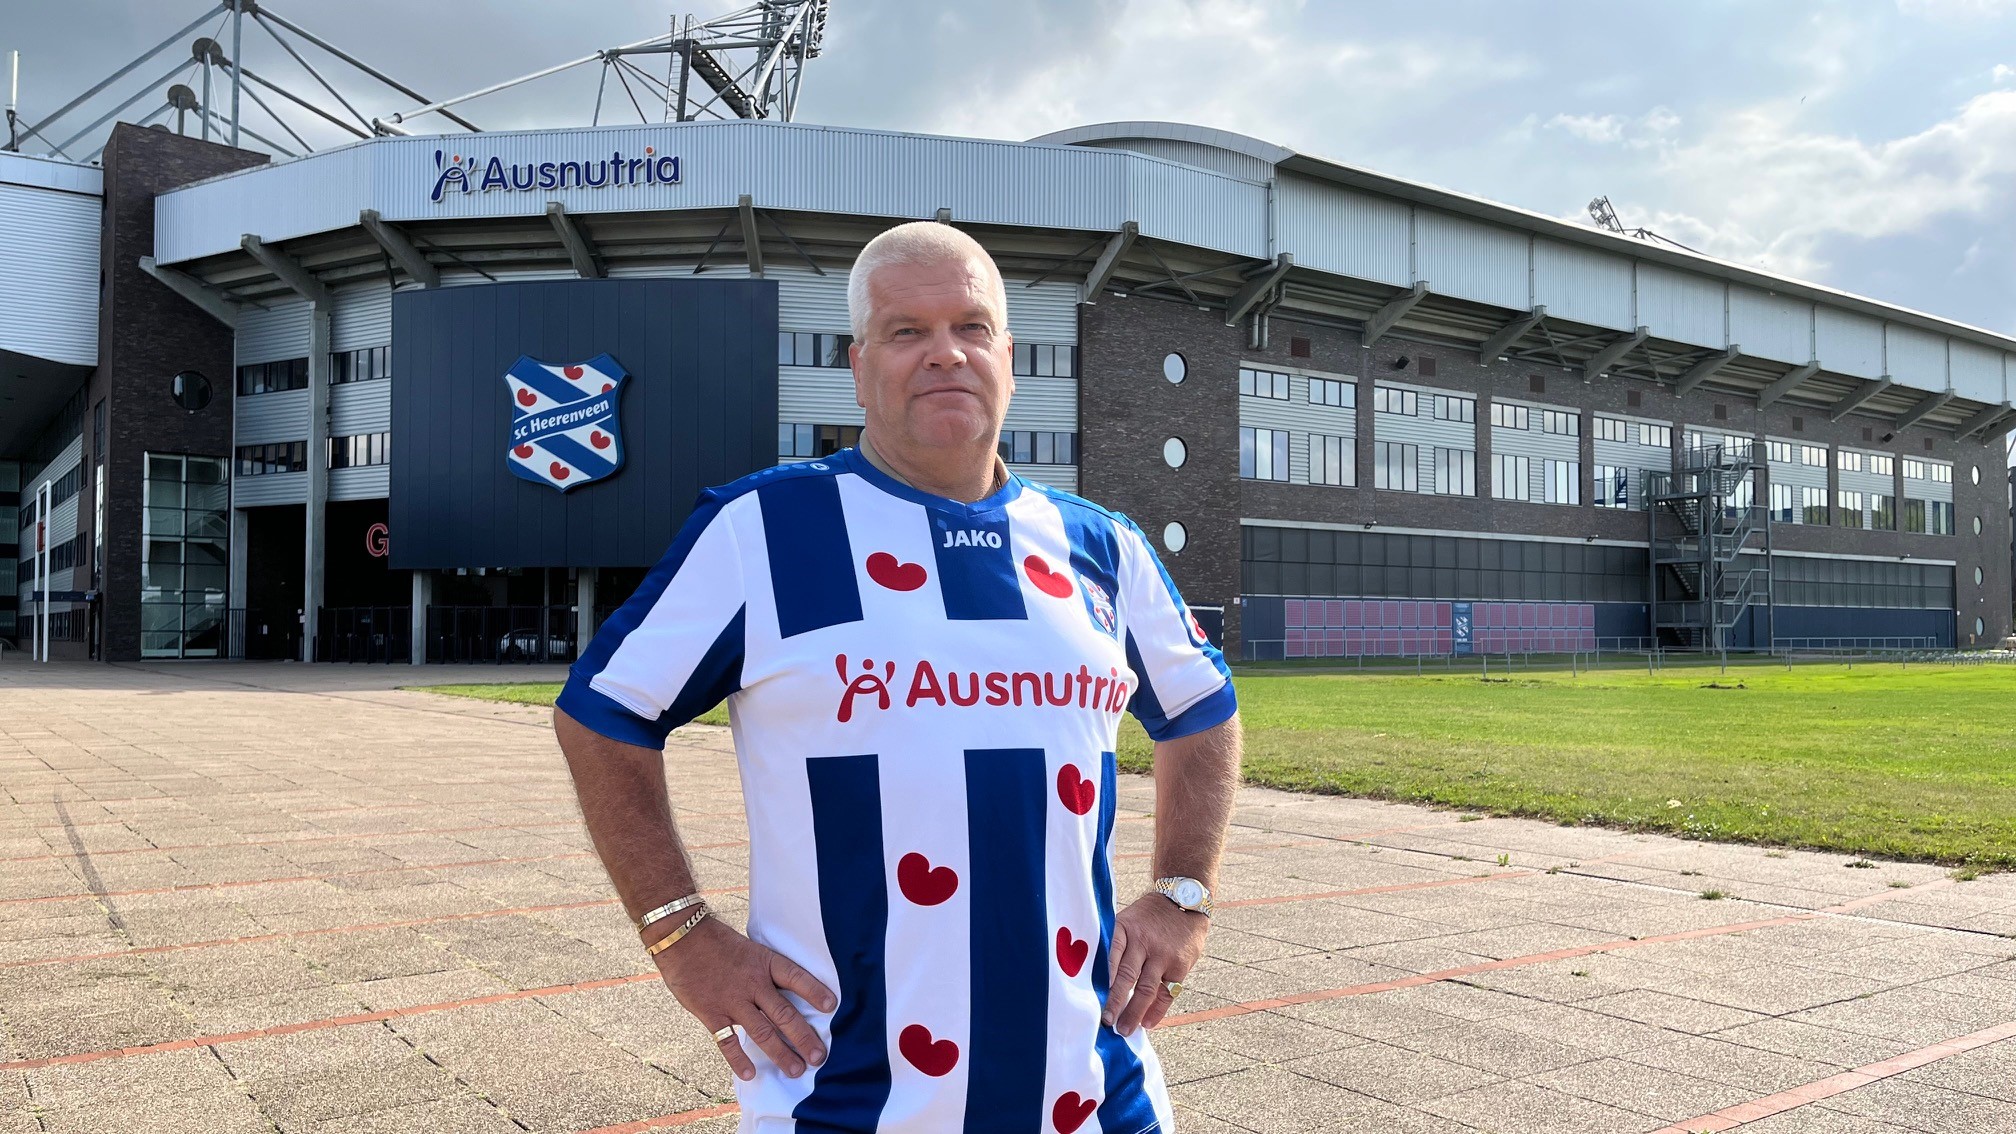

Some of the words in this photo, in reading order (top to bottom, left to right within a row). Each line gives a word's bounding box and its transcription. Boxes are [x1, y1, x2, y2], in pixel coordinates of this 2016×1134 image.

[481, 147, 681, 191] Ausnutria
[514, 425, 528, 440] sc
[530, 400, 609, 433] Heerenveen
[366, 523, 389, 557] G
[943, 529, 1003, 549] JAKO
